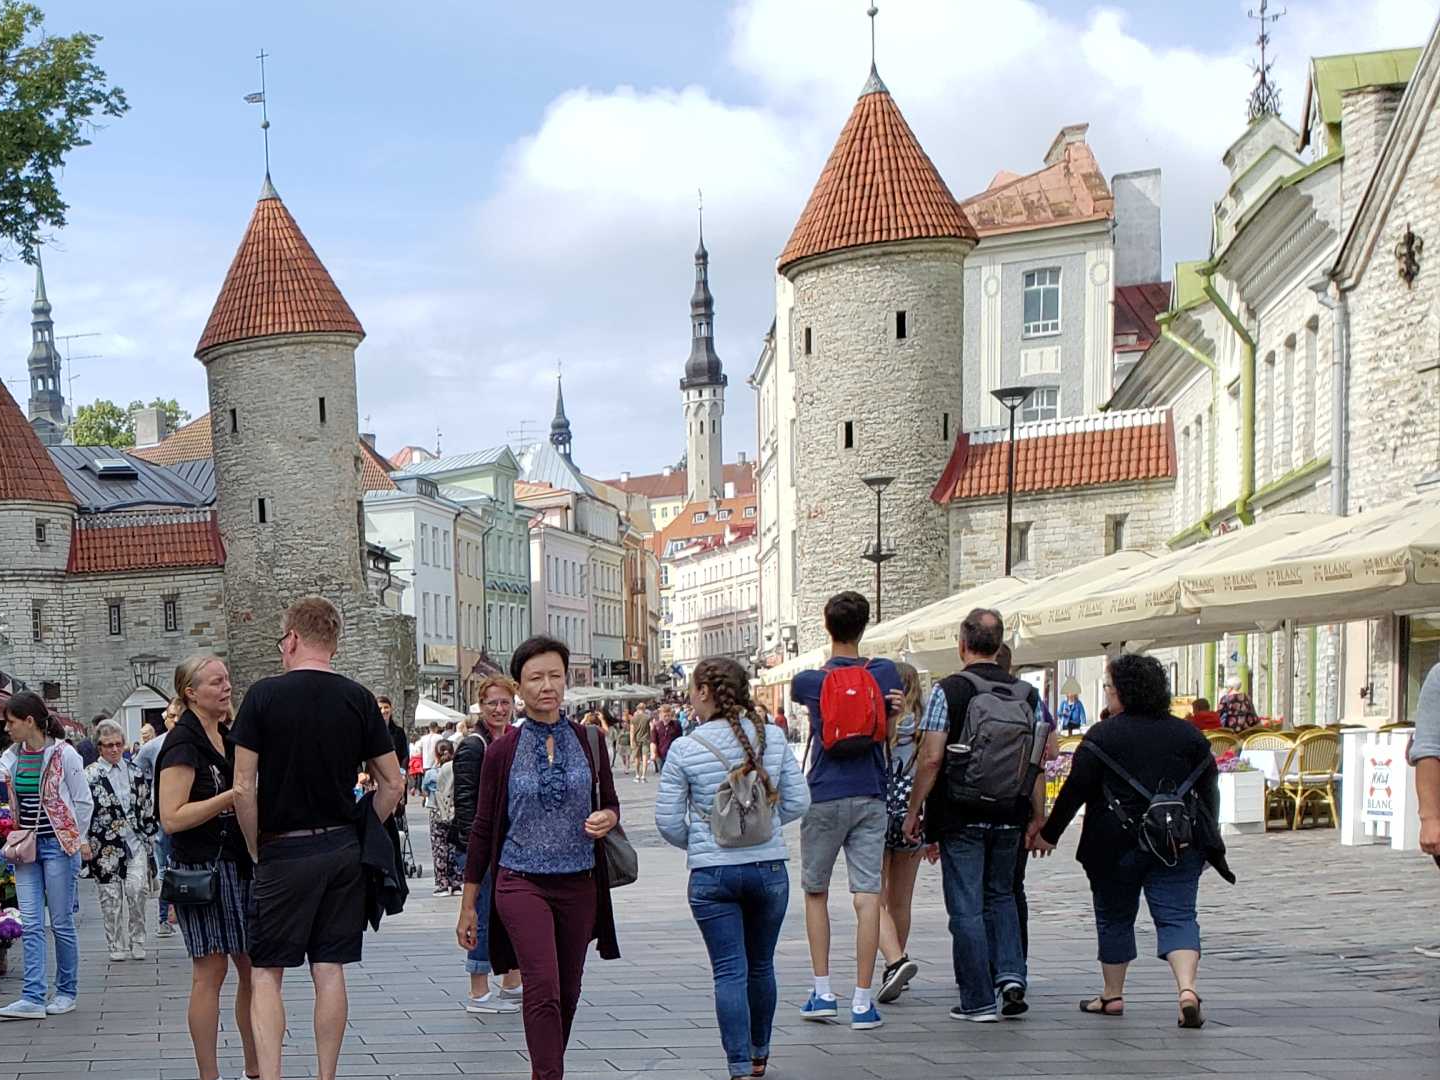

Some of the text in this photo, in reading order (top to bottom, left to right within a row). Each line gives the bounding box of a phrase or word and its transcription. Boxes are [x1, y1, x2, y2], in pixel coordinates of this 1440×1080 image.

[1275, 567, 1302, 581] BLANC
[1323, 561, 1352, 576] BLANC
[1367, 798, 1393, 809] BLANC
